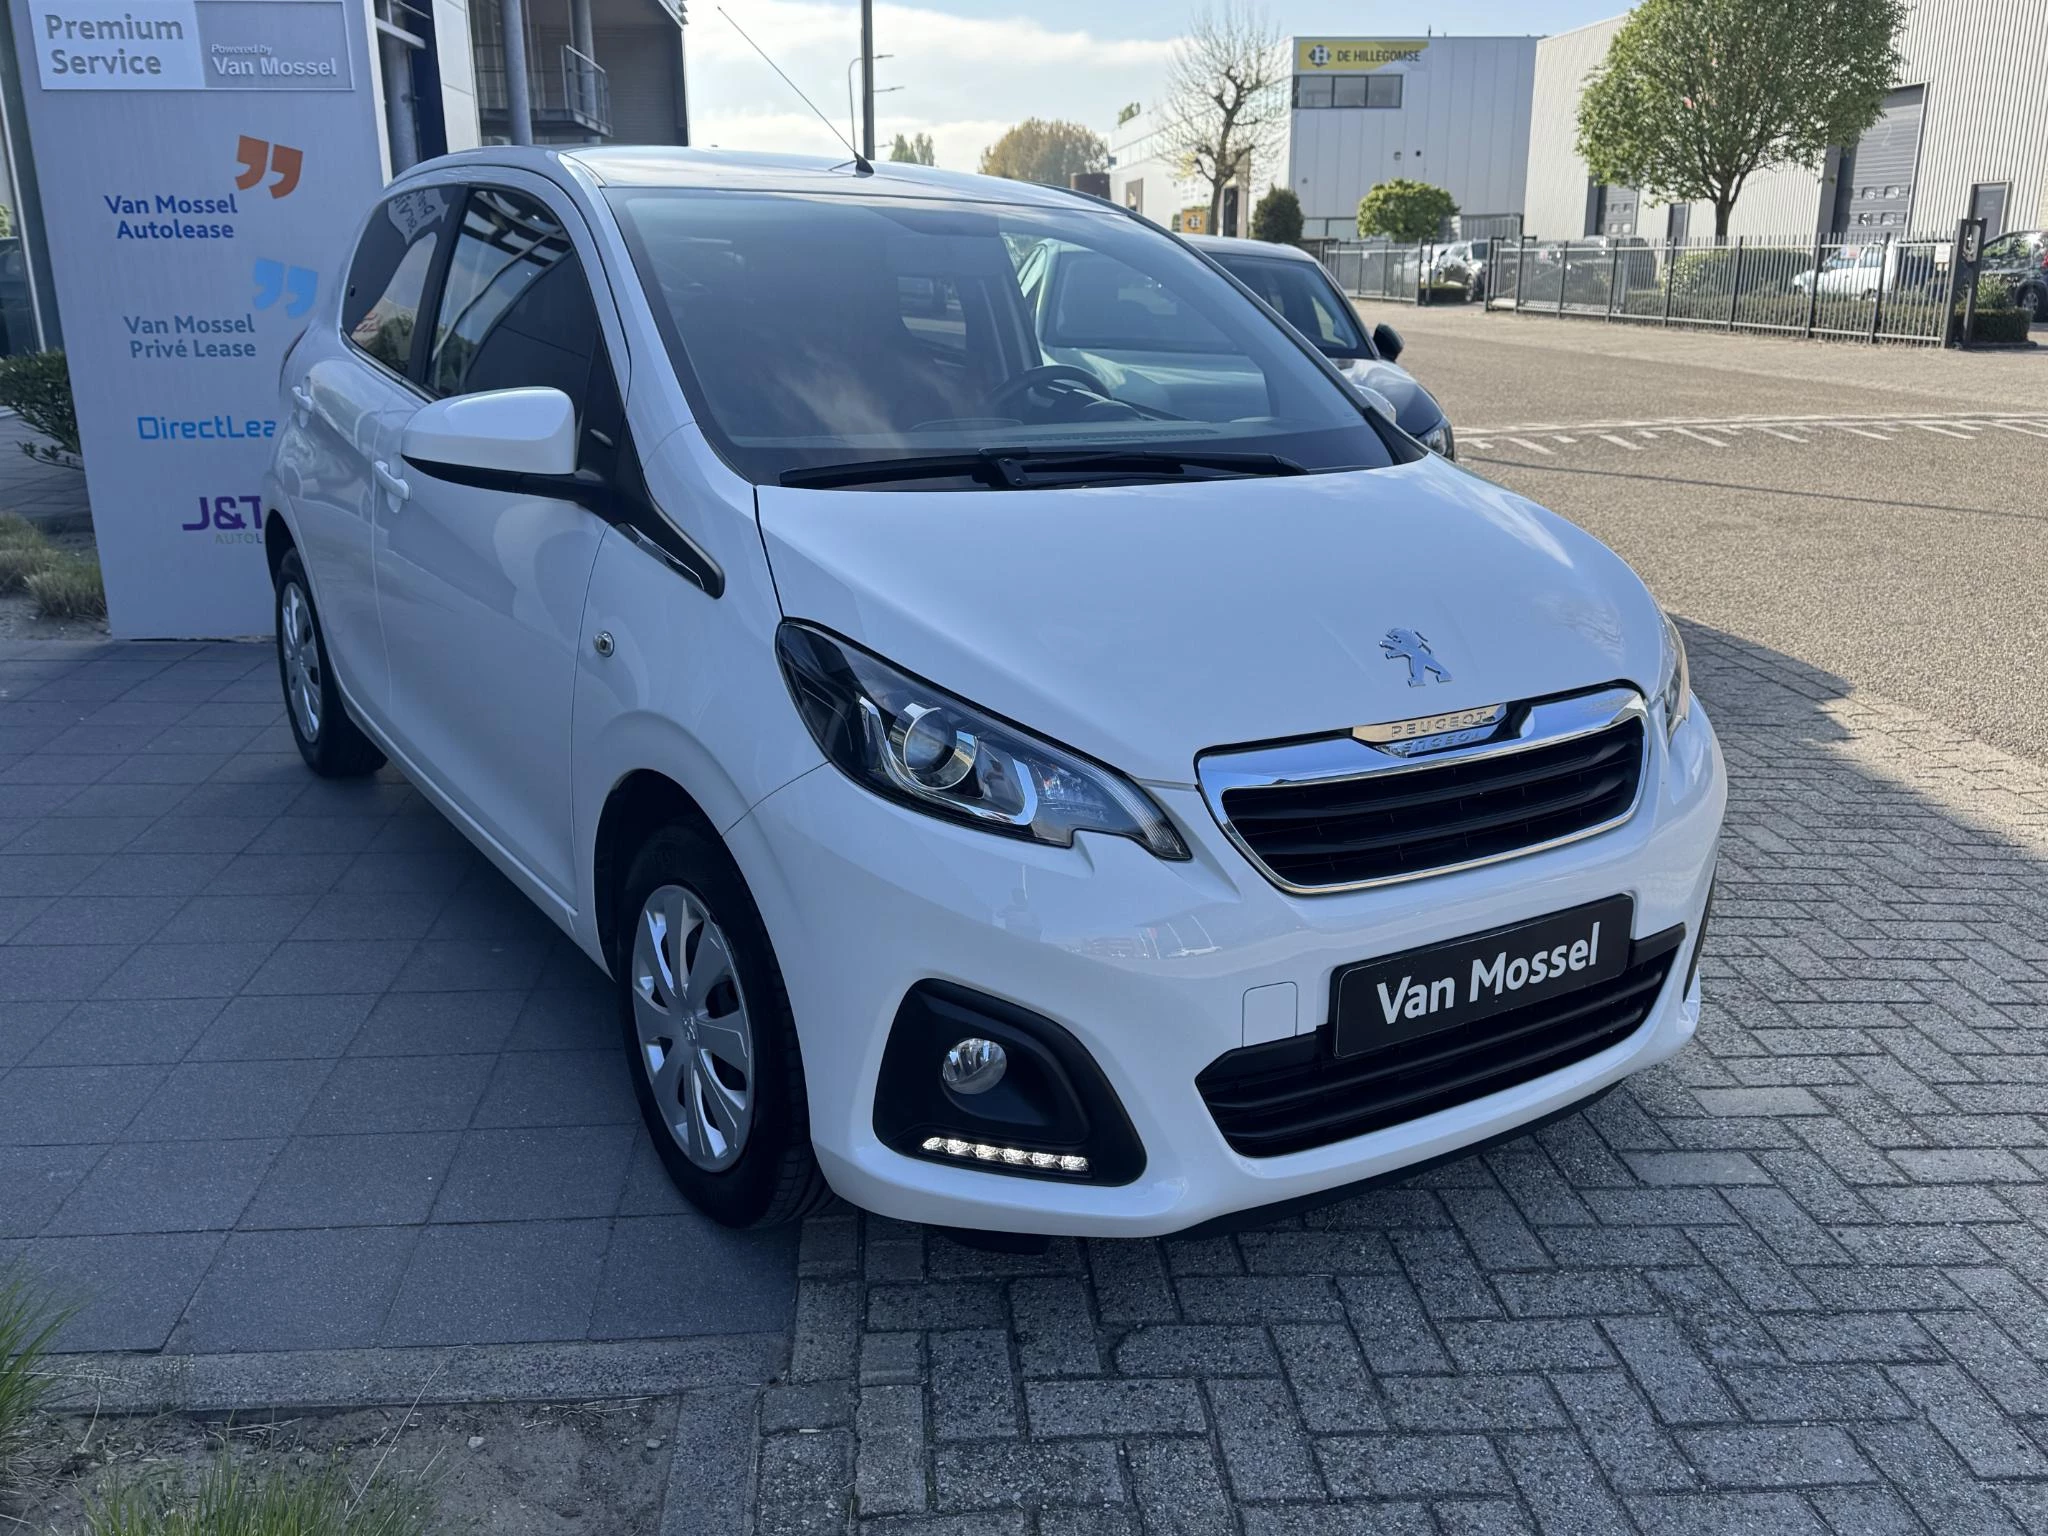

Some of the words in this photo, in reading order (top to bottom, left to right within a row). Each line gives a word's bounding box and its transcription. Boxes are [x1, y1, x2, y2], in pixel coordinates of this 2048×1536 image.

[45, 13, 184, 41] Premium
[211, 43, 257, 54] Powered
[259, 43, 273, 56] by
[1337, 50, 1352, 62] DE
[1354, 50, 1420, 62] HILLEGOMSE
[50, 48, 162, 75] Service
[212, 57, 254, 77] Van
[259, 57, 338, 77] Mossel
[104, 194, 149, 214] Van
[155, 193, 239, 214] Mossel
[116, 218, 235, 239] Autolease
[123, 315, 169, 334] Van
[174, 313, 256, 334] Mossel
[130, 338, 188, 358] Privé
[193, 339, 257, 357] Lease
[1391, 711, 1487, 738] PEUGEOT
[1376, 975, 1456, 1025] Van
[1469, 921, 1601, 1003] Mossel
